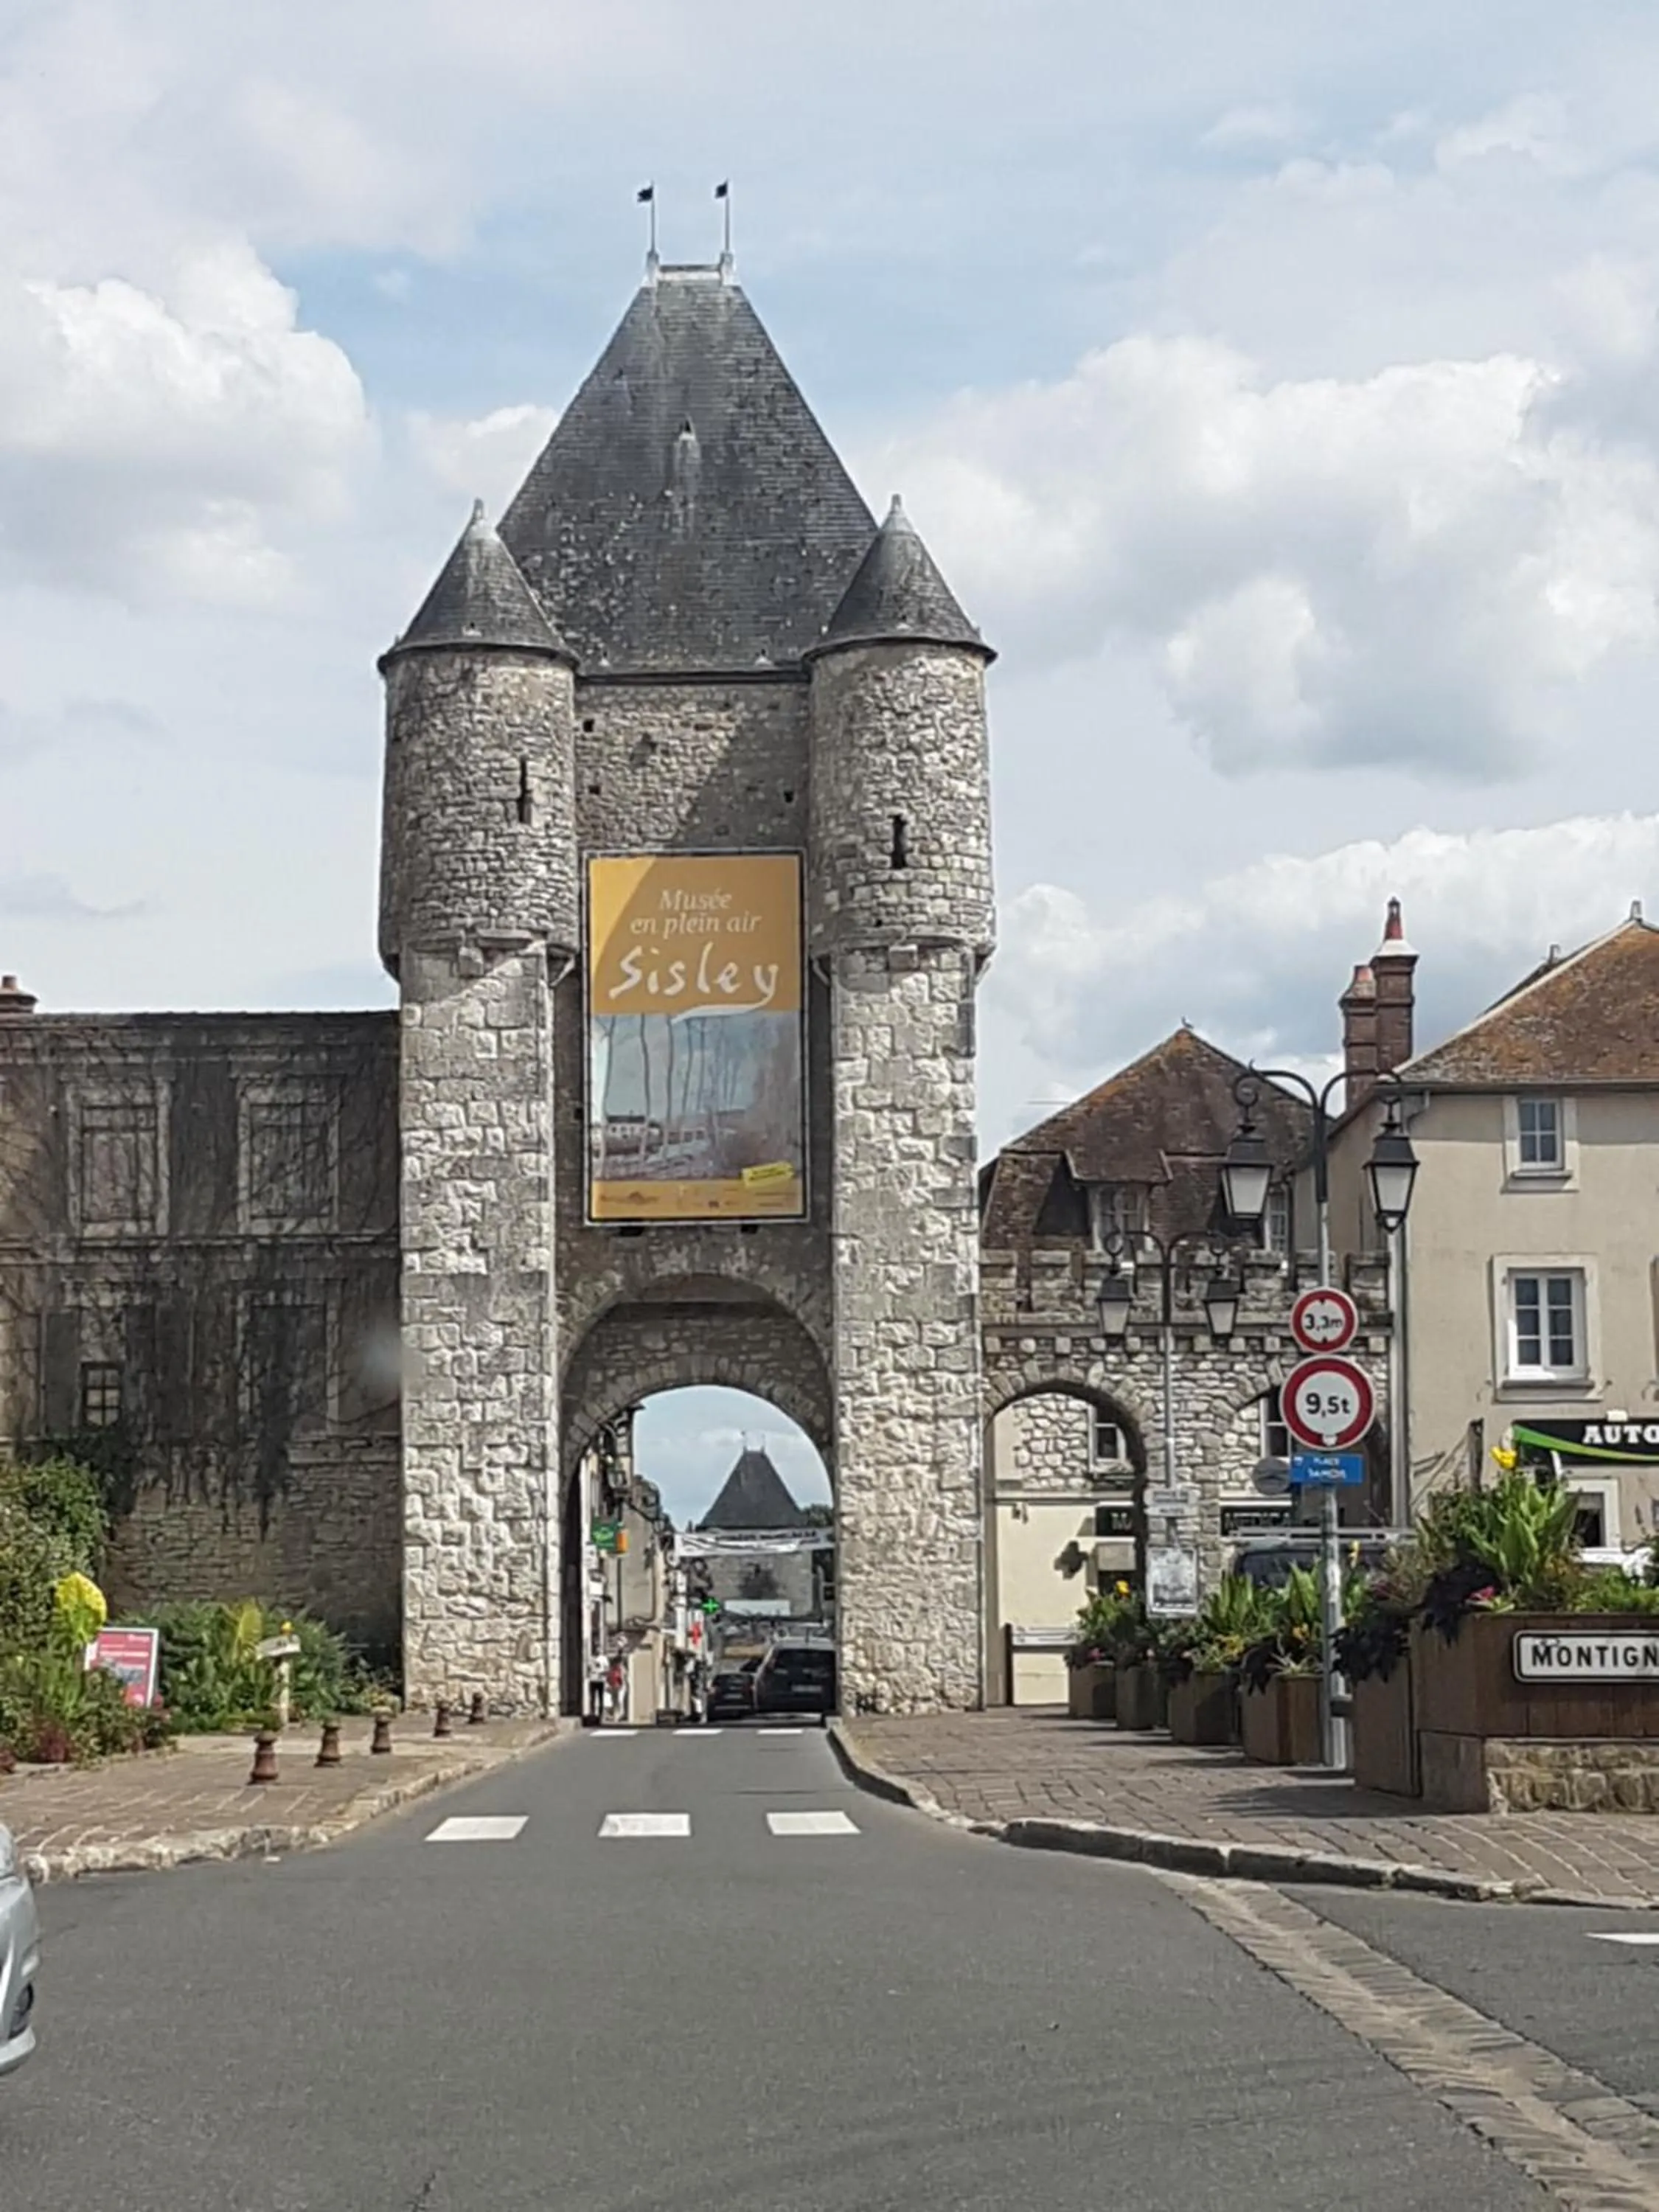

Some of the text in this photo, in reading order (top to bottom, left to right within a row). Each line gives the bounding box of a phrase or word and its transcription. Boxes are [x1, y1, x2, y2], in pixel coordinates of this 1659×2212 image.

[659, 887, 731, 911] Musée
[630, 911, 762, 939] en plein air
[608, 942, 779, 1023] Sisley
[1305, 1392, 1351, 1418] 9,5t
[1582, 1425, 1659, 1444] AUTO
[1531, 1644, 1659, 1667] MONTIGN
